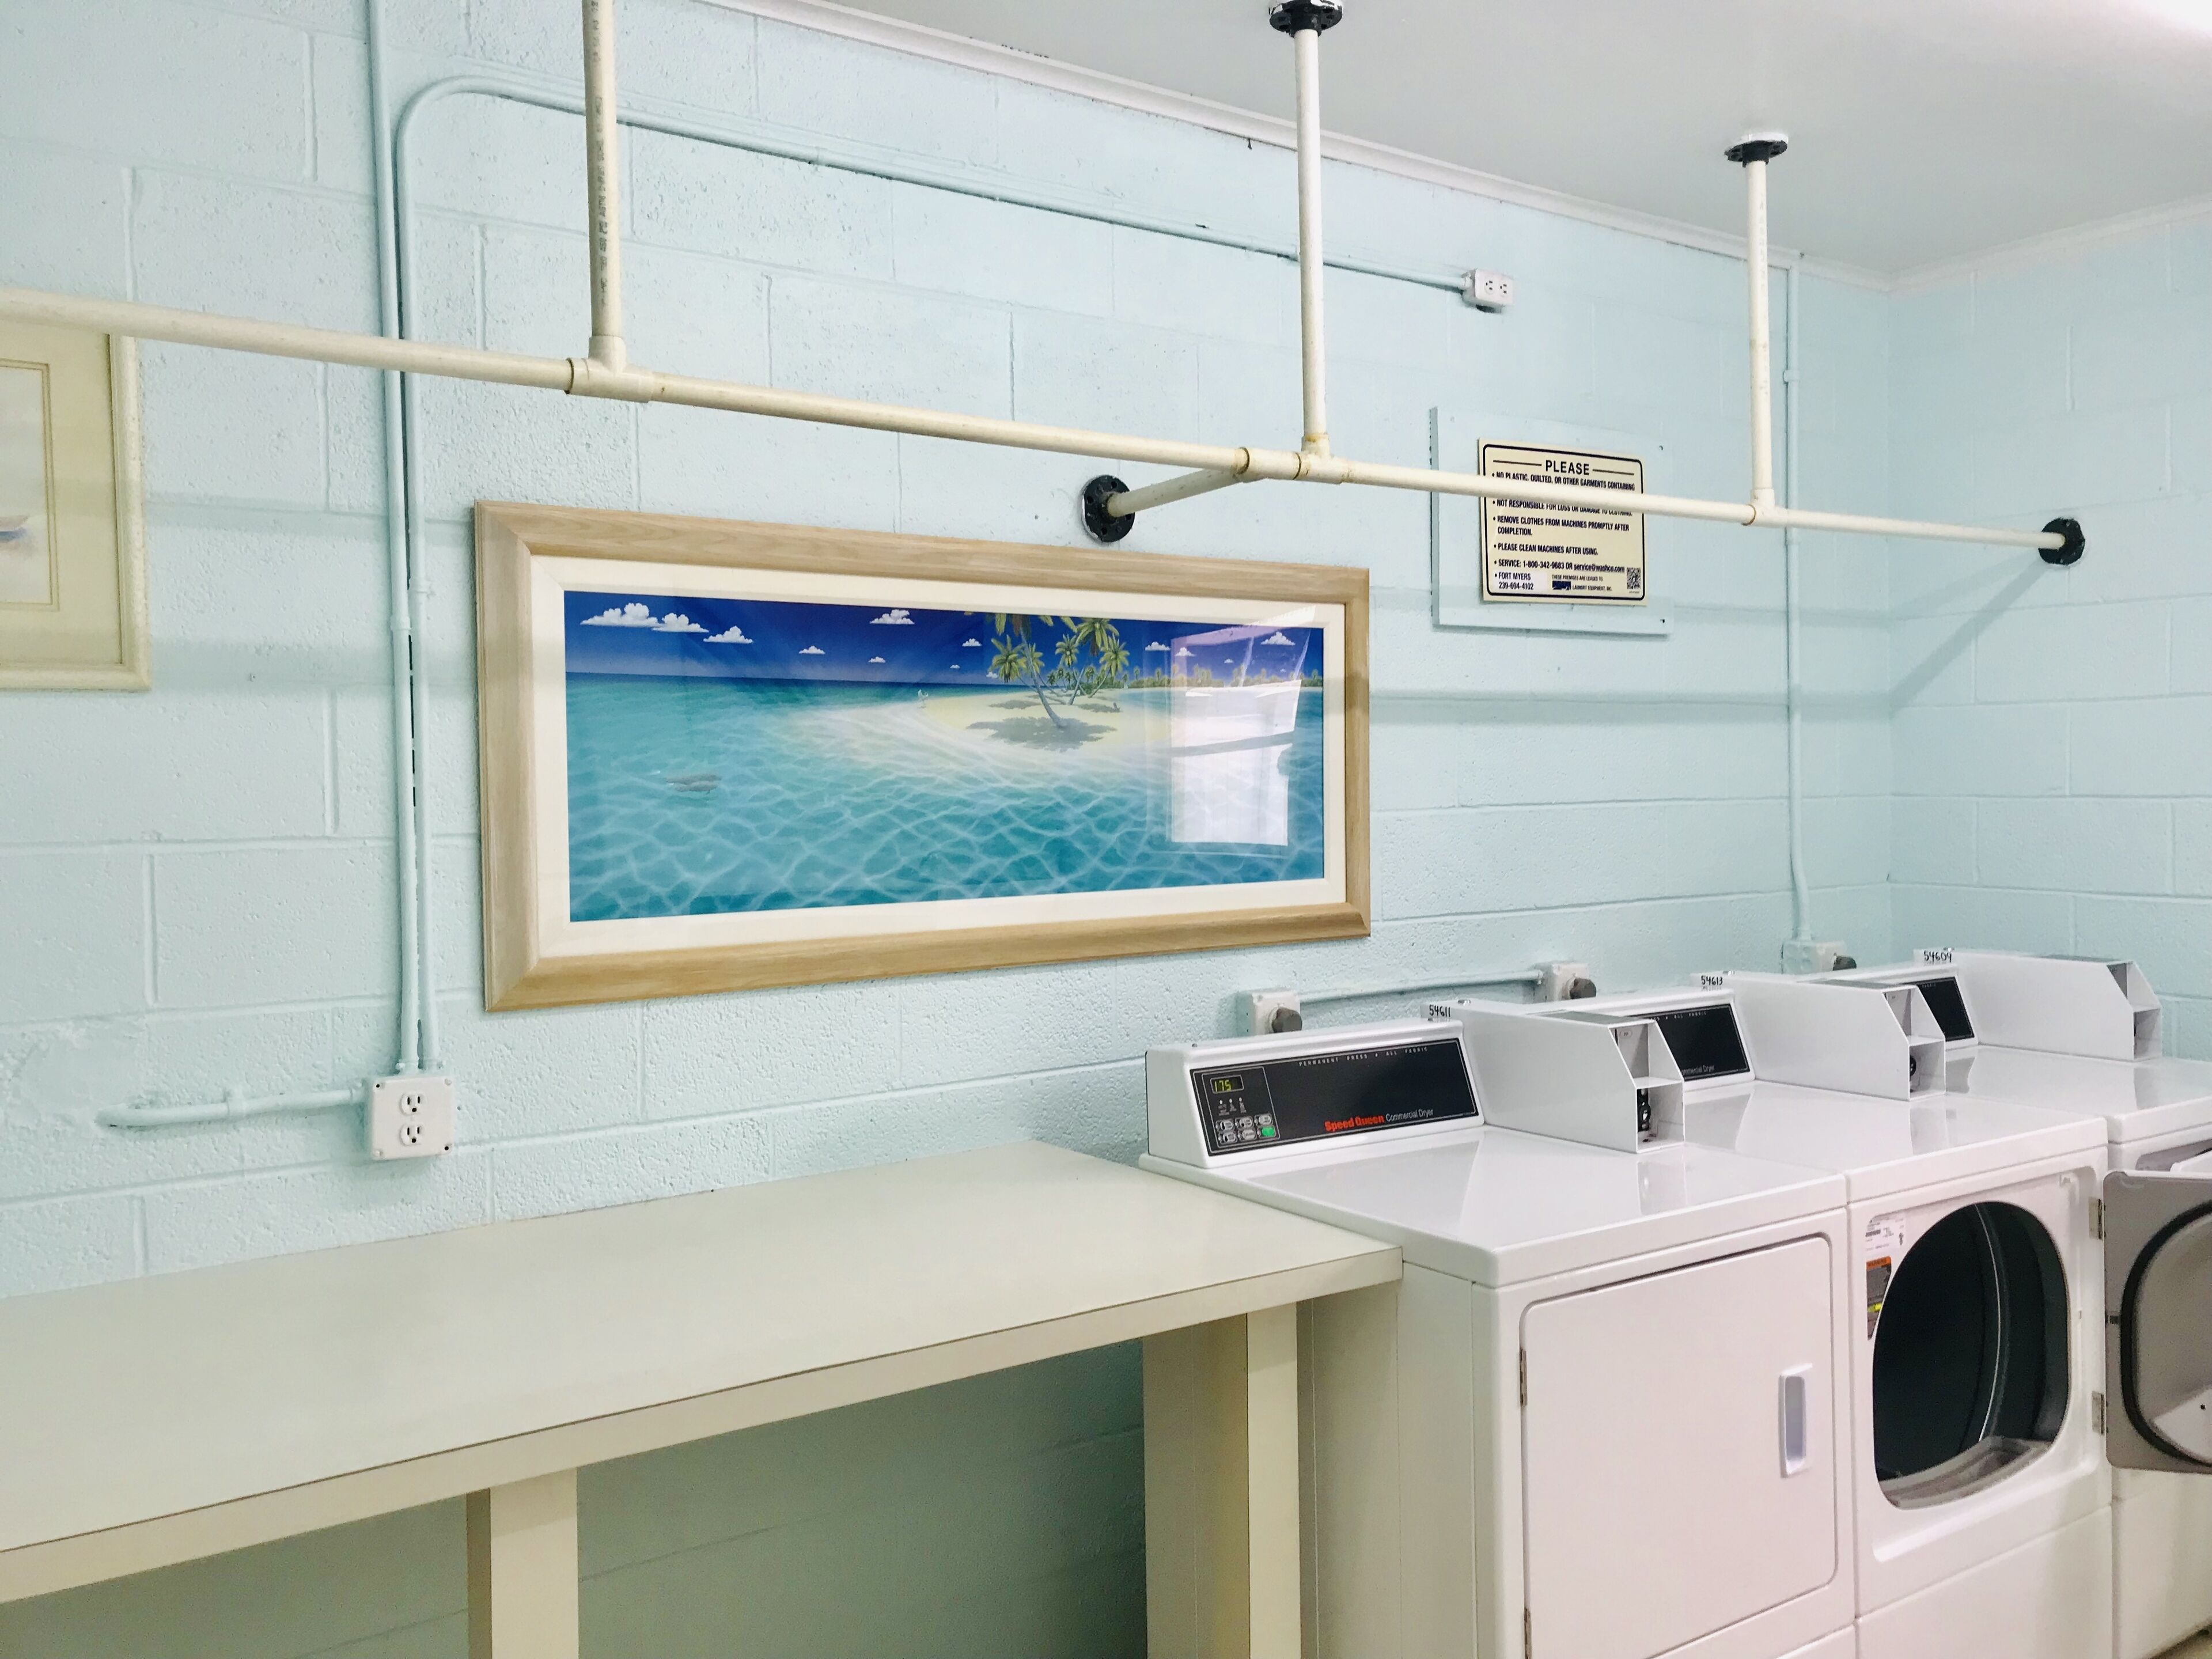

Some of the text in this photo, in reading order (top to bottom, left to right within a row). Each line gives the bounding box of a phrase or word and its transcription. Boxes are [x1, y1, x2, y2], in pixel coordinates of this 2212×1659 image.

[1546, 460, 1590, 475] PLEASE
[1554, 476, 1562, 484] OR
[1563, 477, 1579, 485] OTHER
[1580, 479, 1607, 488] GARMENTS
[1607, 481, 1635, 491] CONTAINING
[1497, 499, 1508, 507] NOT
[1509, 499, 1545, 510] RESPONSIBLE
[1498, 515, 1519, 524] REMOVE
[1520, 516, 1544, 525] CLOTHES
[1545, 518, 1560, 527] FROM
[1561, 520, 1587, 528] MACHINES
[1588, 521, 1613, 531] PROMPTLY
[1498, 526, 1533, 536] COMPLETION.
[1498, 543, 1518, 551] PLEASE
[1519, 544, 1536, 552] CLEAN
[1537, 545, 1565, 554] MACHINES
[1498, 559, 1521, 567] SERVICE:
[1523, 560, 1564, 570] 1-800-342-9683
[1498, 572, 1531, 581] FORT MYERS
[1499, 582, 1534, 590] 239-694-4102
[1701, 975, 1723, 986] 54613
[1429, 1005, 1450, 1017] 54611
[1299, 1057, 1339, 1067] PERMANENT
[1214, 1080, 1232, 1092] 175
[1324, 1108, 1434, 1132] Speed Queen Commercial Dryer
